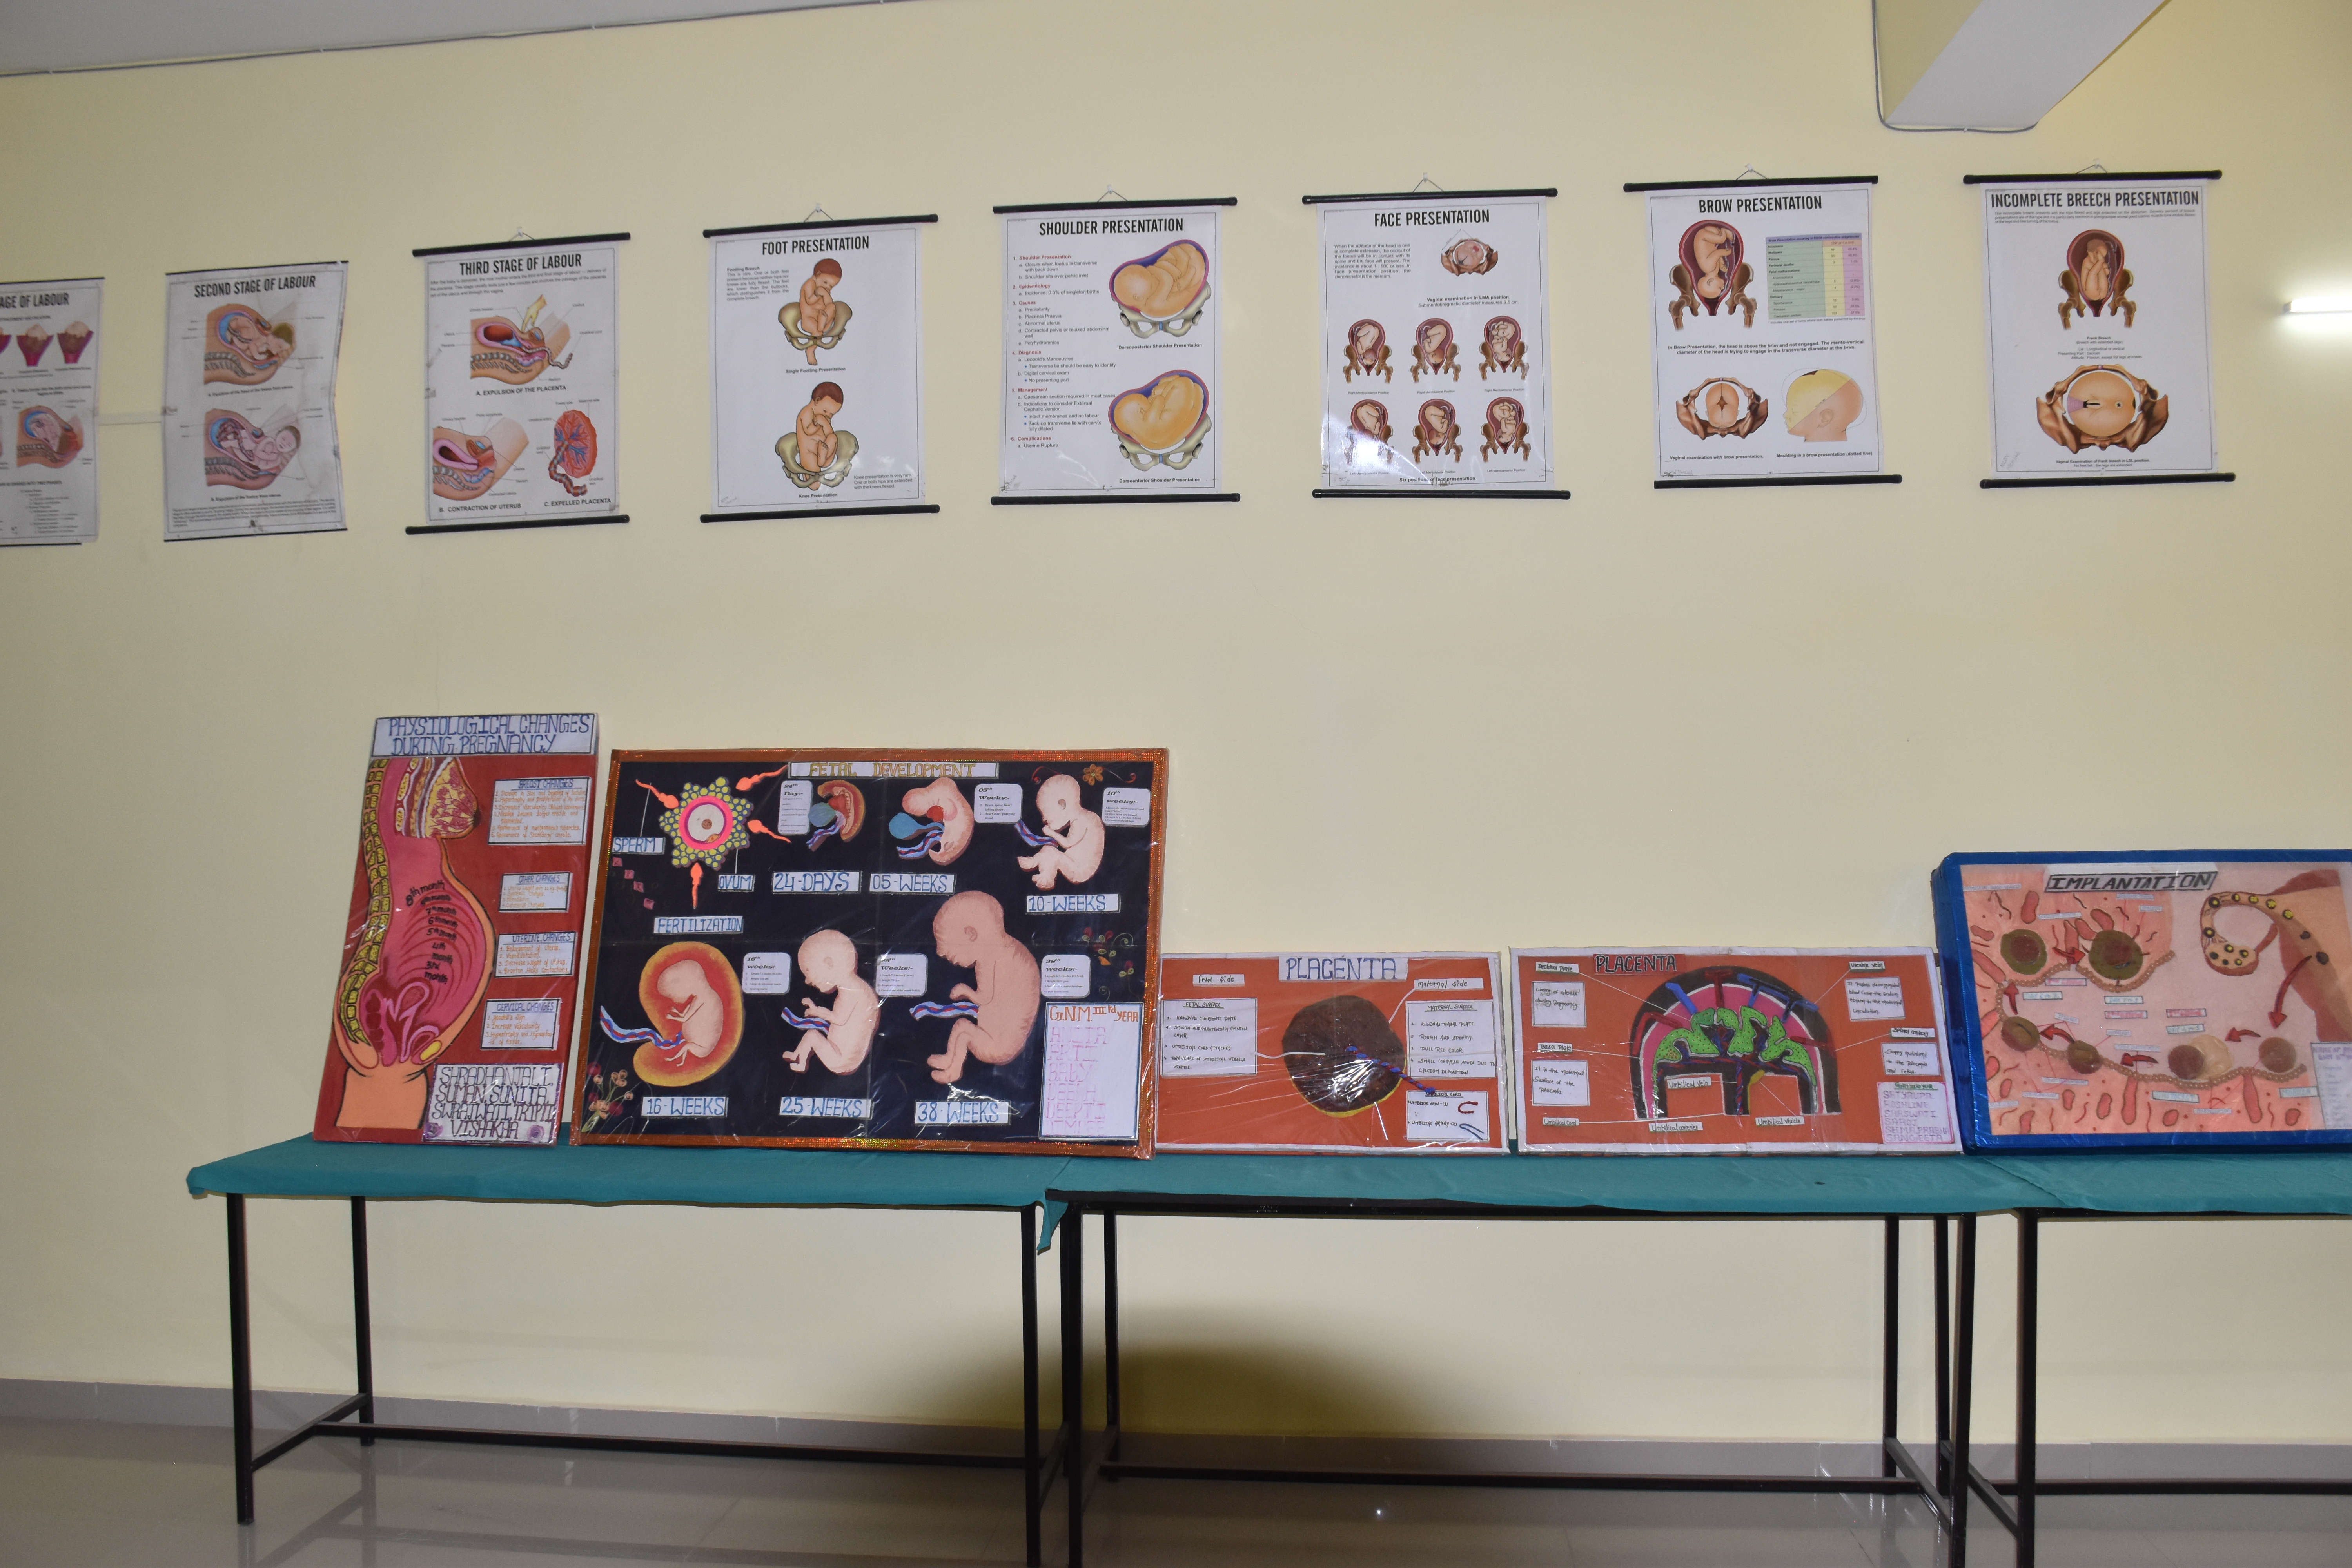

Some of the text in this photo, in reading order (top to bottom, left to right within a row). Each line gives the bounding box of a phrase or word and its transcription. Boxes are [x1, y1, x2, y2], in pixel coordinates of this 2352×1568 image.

[1699, 196, 1822, 213] BROW PRESENTATION
[1991, 191, 2198, 207] INCOMPLETE BREECH PRESENTATION
[1375, 209, 1489, 227] FACE PRESENTATION
[1040, 218, 1183, 235] SHOULDER PRESENTATION
[762, 236, 869, 255] FOOT PRESENTATION
[460, 254, 581, 275] THIRD STAGE OF LABOUR
[194, 276, 316, 298] SECOND STAGE OF LABOUR
[20, 295, 31, 308] OF
[33, 293, 69, 307] LABOUR
[389, 715, 590, 737] PHYSIOLOGICAL CHANGES
[391, 734, 557, 755] DURING PREGNANCY
[809, 762, 976, 777] FETAL DEVELOPMENT
[613, 838, 656, 852] SPERM
[719, 876, 752, 889] OVUM
[2051, 874, 2212, 889] IMPLANTATION
[658, 917, 742, 933] FERTILIZATION
[512, 933, 571, 943] UTERINE CHANGES
[1286, 956, 1396, 980] PLACENTA
[1595, 954, 1677, 973] PLACENTA
[497, 1002, 554, 1011] CERVICAL CHANGES
[1114, 1011, 1138, 1022] YEAR
[1668, 1080, 1695, 1088] Umbilical
